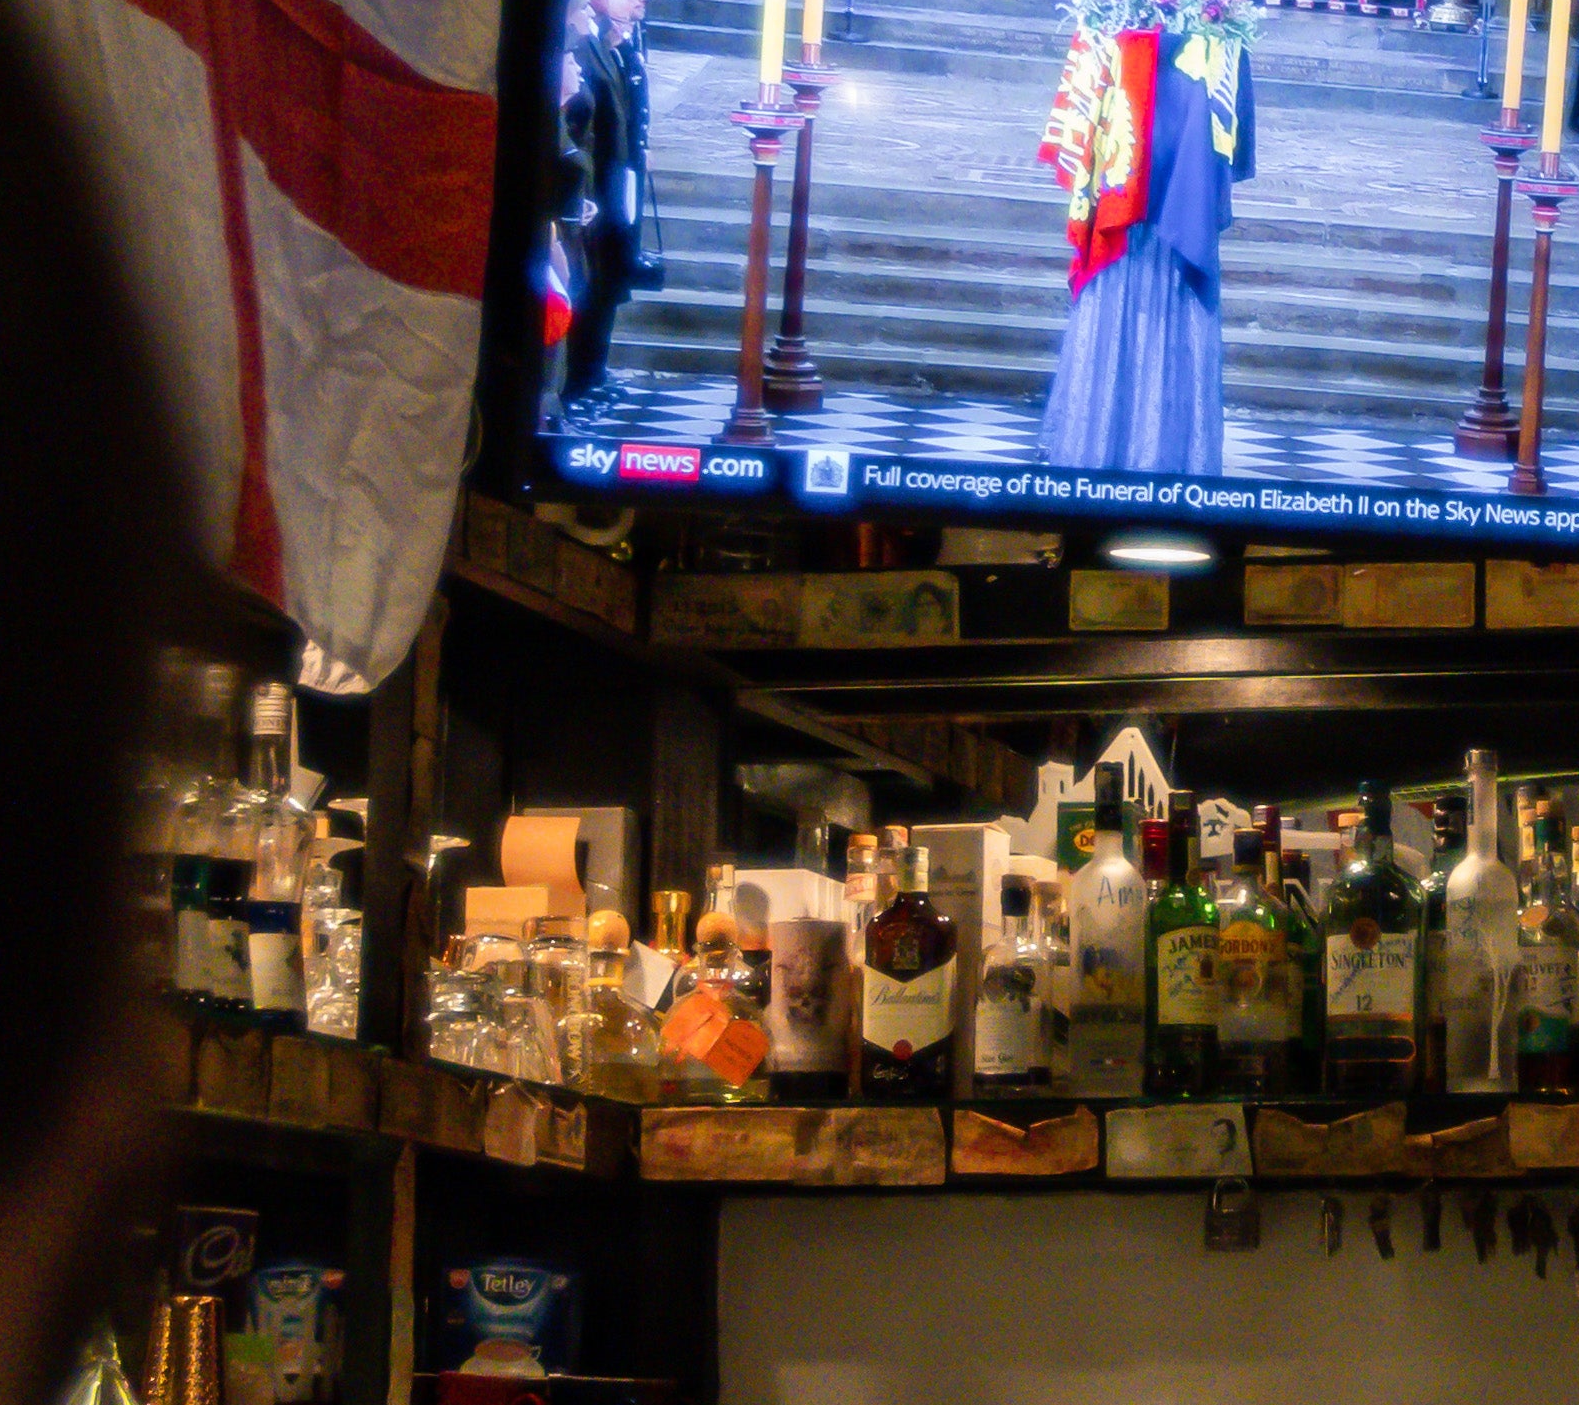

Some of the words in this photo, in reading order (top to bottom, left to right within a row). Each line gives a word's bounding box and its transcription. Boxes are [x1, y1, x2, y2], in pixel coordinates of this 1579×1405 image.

[569, 443, 618, 474] sky
[624, 448, 695, 474] news
[864, 465, 900, 488] Full
[906, 470, 1002, 497] coverage
[1006, 474, 1033, 495] of
[1034, 476, 1071, 497] the
[1076, 478, 1154, 502] Funeral
[1158, 483, 1182, 504] of
[1185, 484, 1255, 509] Queen
[1260, 489, 1352, 514] Elizabeth
[1358, 495, 1369, 515] II
[1373, 500, 1400, 517] on
[1405, 498, 1440, 520] the
[1445, 501, 1481, 526] Sky
[1485, 503, 1540, 526] News
[1331, 951, 1405, 971] SINGLETON
[1356, 993, 1373, 1012] 12
[480, 1272, 536, 1300] Tetley
